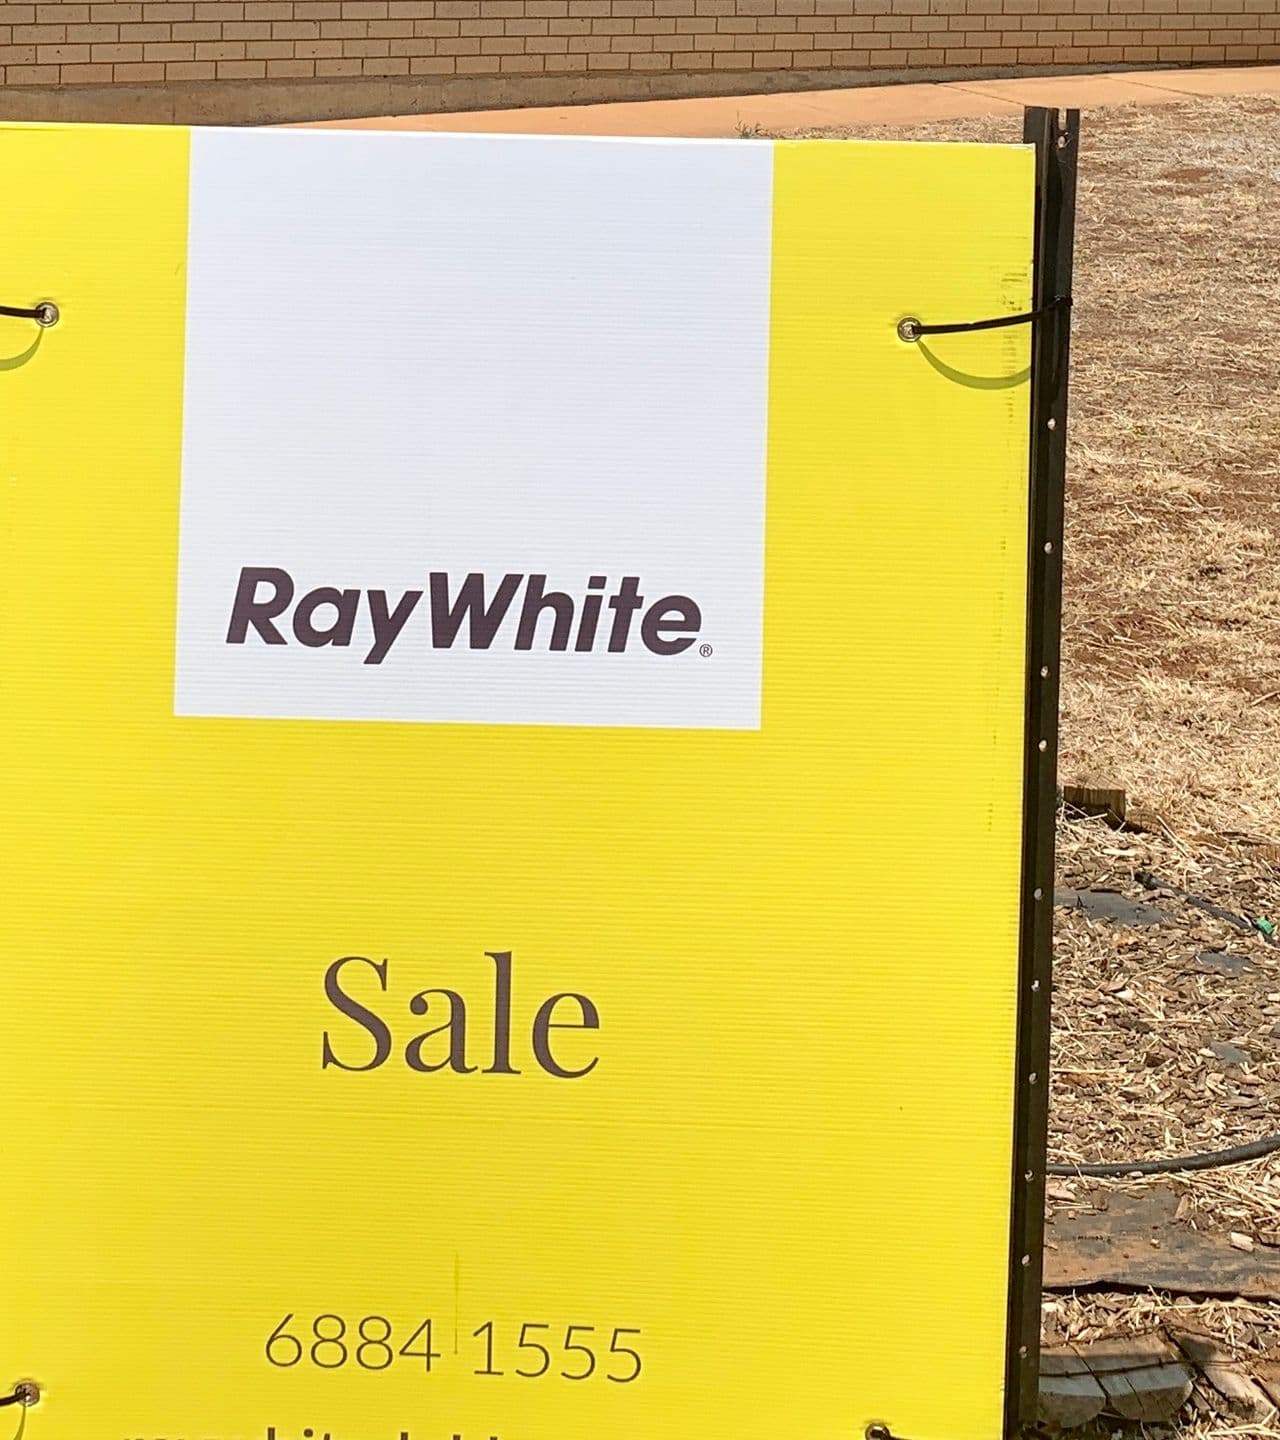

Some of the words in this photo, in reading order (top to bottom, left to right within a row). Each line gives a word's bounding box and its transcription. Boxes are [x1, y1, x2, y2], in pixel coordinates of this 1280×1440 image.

[322, 951, 600, 1078] Sale
[264, 1313, 441, 1372] 6884
[472, 1320, 642, 1383] 1555
